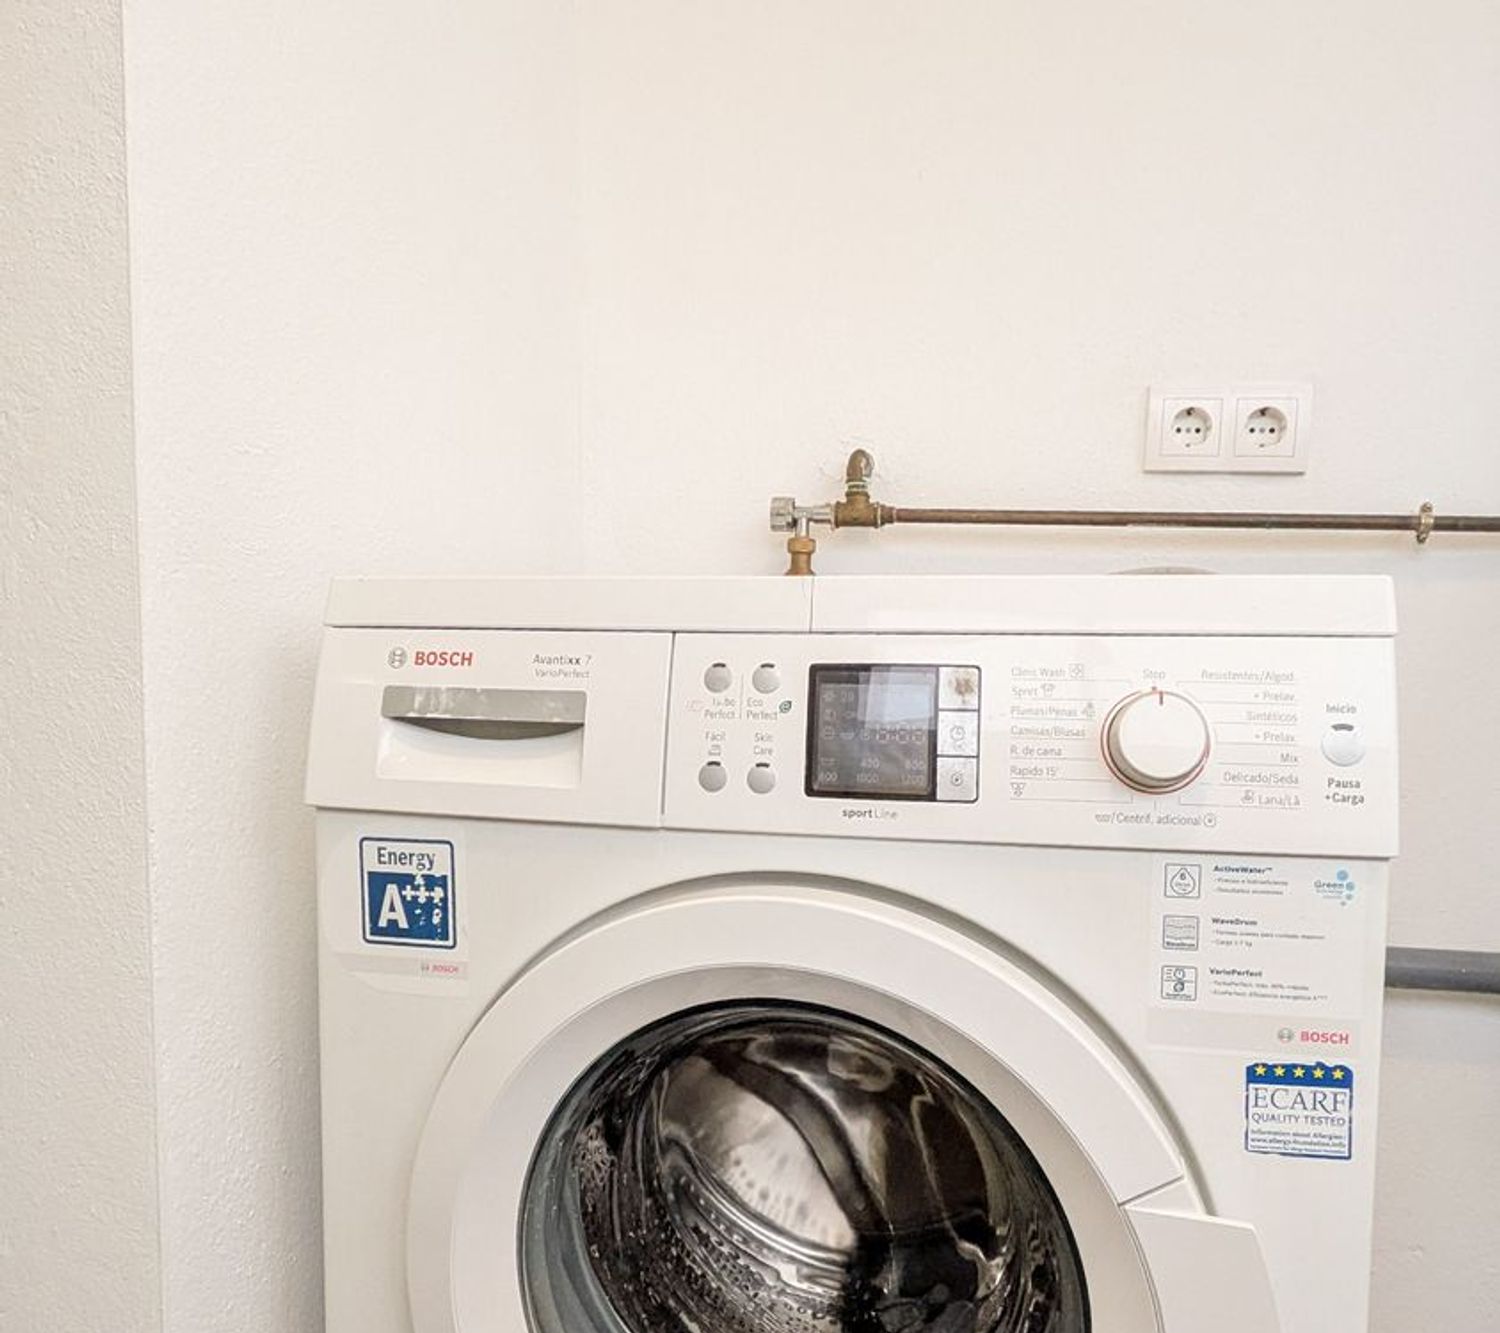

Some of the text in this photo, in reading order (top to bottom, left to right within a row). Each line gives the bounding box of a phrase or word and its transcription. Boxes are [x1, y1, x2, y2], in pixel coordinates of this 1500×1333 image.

[413, 651, 474, 667] BOSCH
[532, 654, 592, 666] Avantixx 7
[534, 668, 591, 679] VarioPerfect
[1142, 668, 1166, 680] Stop
[747, 697, 764, 707] Eco
[704, 709, 735, 720] Perfect
[746, 710, 778, 720] Perfect
[753, 745, 774, 756] Care
[1022, 746, 1034, 756] de
[1036, 748, 1062, 756] cama
[1280, 753, 1298, 763] Mix
[1327, 777, 1361, 789] Pausa
[1157, 814, 1201, 826] adicional
[377, 846, 436, 871] Energy
[1300, 1031, 1350, 1045] BOSCH
[1252, 1087, 1347, 1115] ECARF
[1251, 1112, 1346, 1127] QUALITY TESTED
